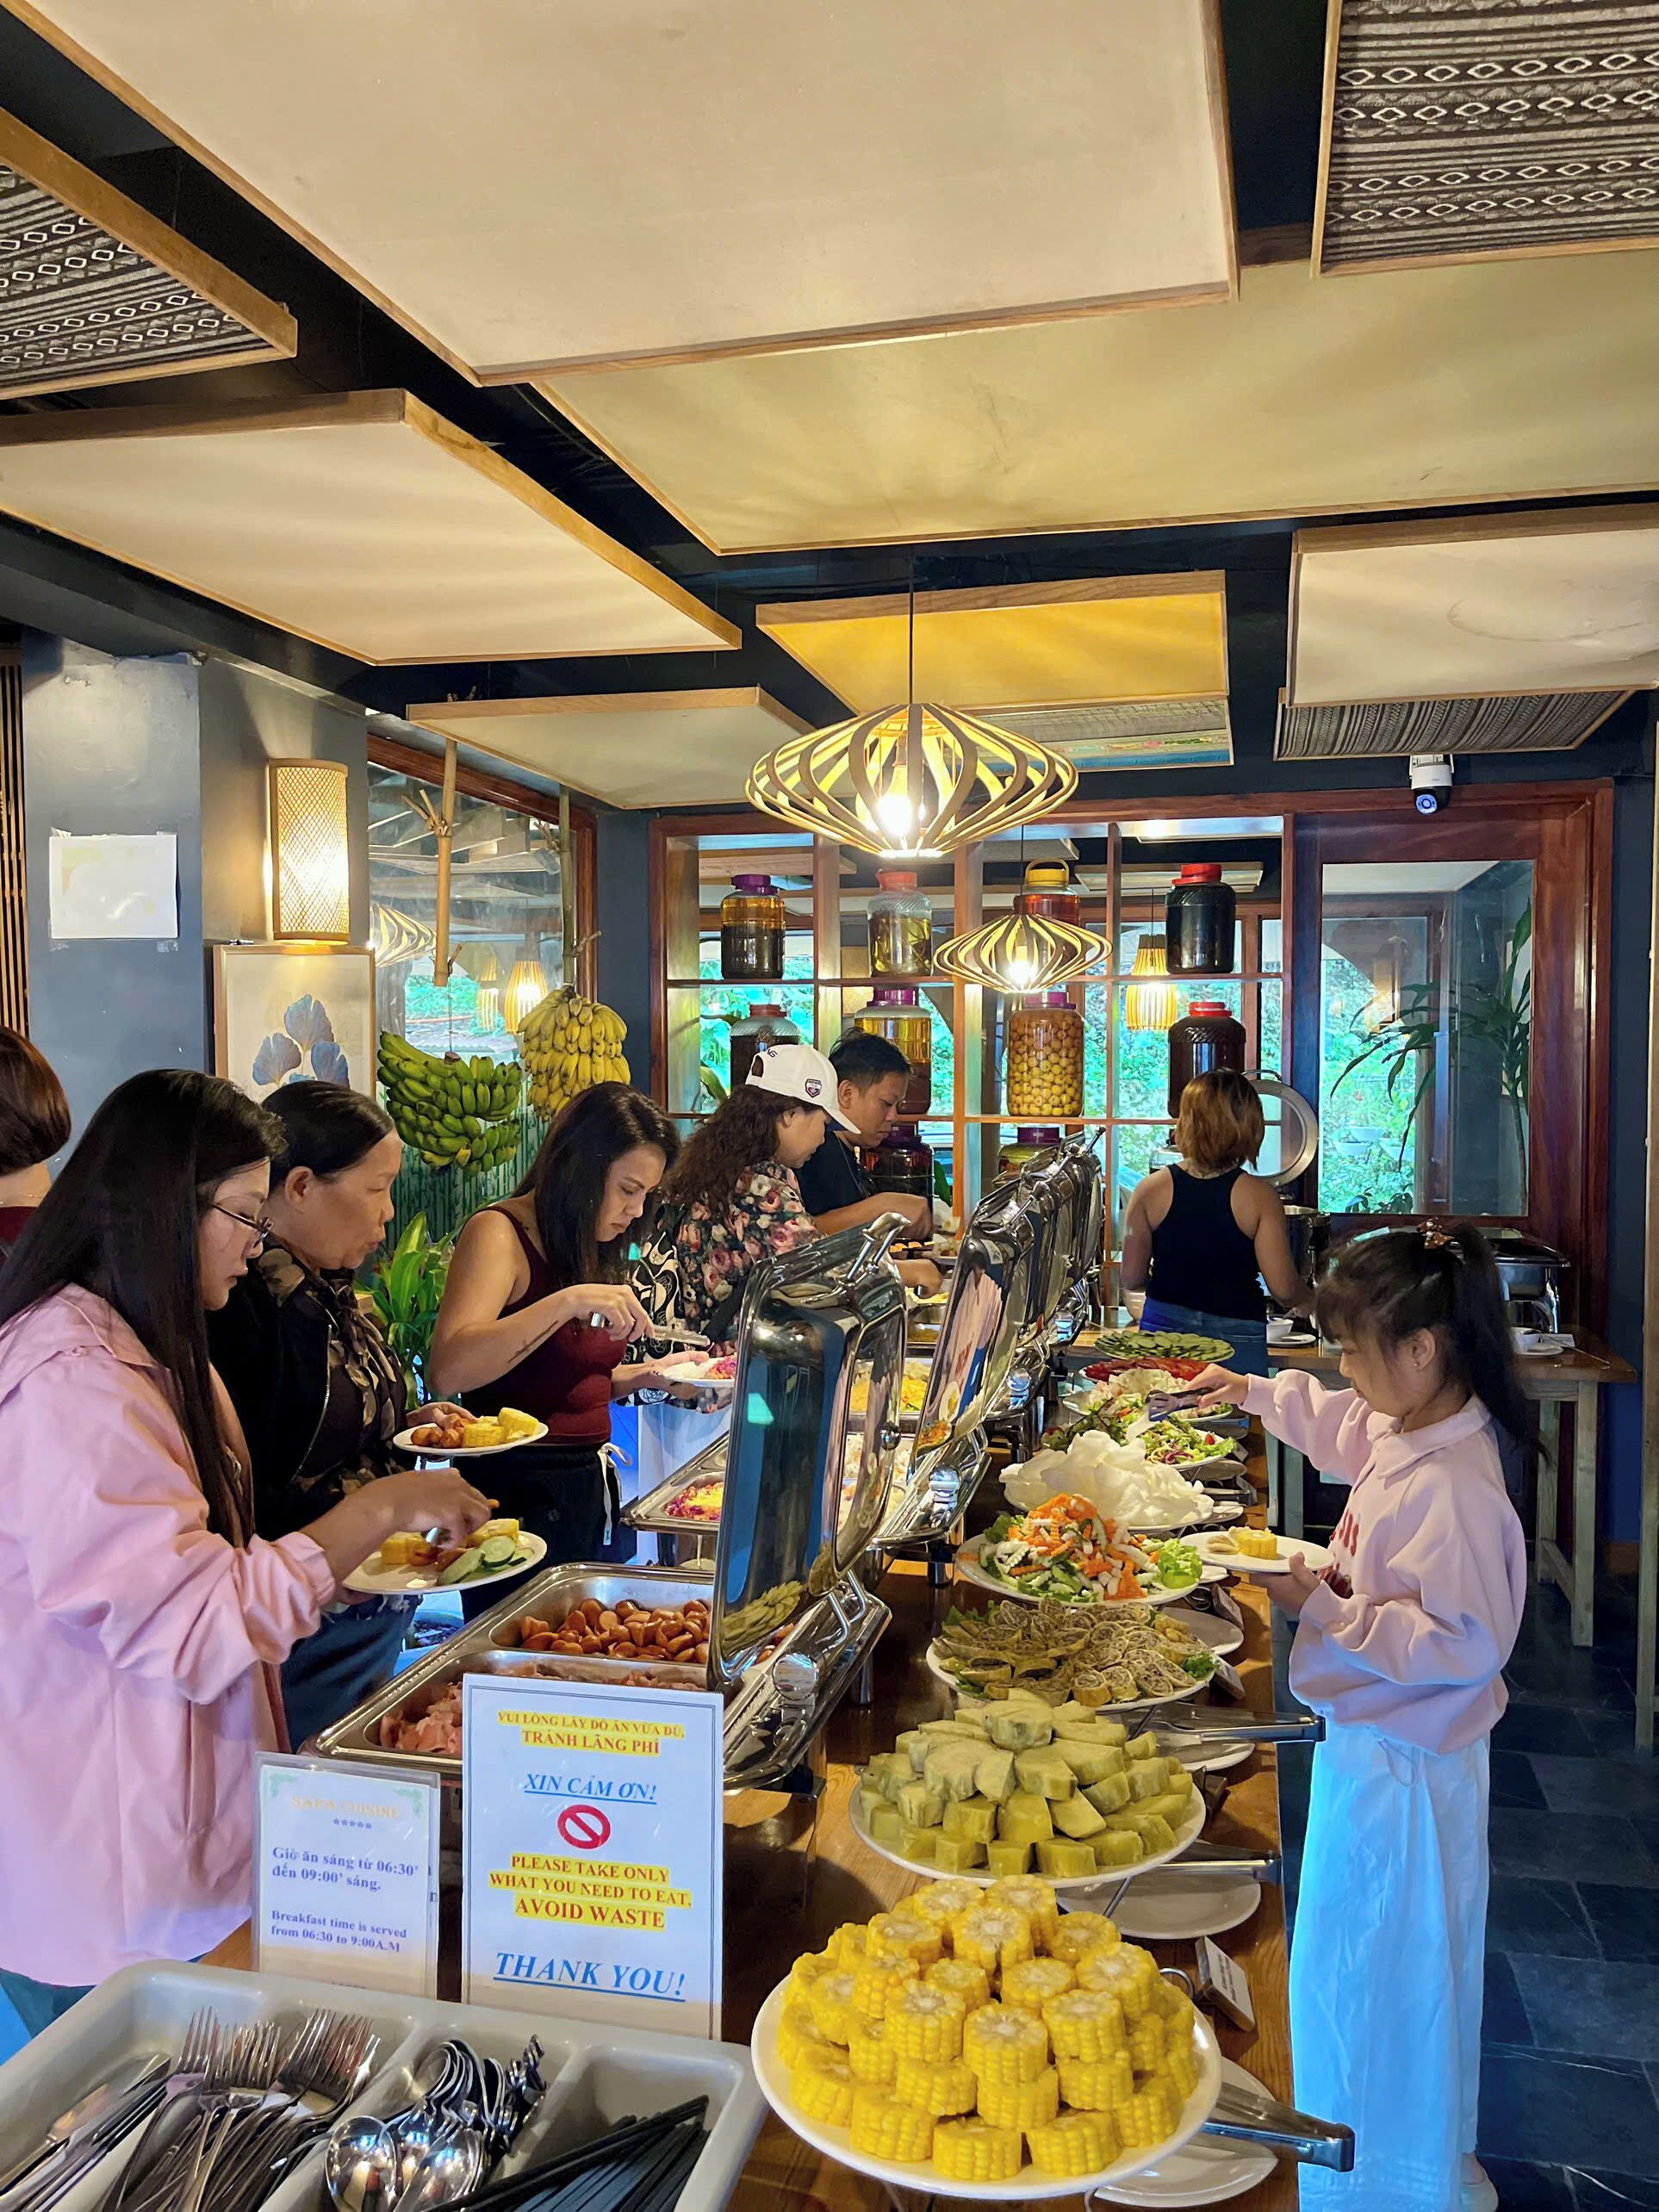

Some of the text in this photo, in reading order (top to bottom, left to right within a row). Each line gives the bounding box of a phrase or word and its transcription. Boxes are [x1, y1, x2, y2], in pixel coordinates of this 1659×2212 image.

[498, 1711, 518, 1724] VUI
[522, 1729, 659, 1754] TRÁNH LÃNG PHÍ
[524, 1774, 657, 1800] XIN CẢM ƠN!
[272, 1846, 299, 1860] Giờ
[302, 1851, 319, 1863] ăn
[323, 1854, 354, 1870] sáng
[511, 1855, 668, 1883] PLEASE TAKE ONLY
[272, 1862, 296, 1878] đến
[346, 1874, 382, 1892] sáng.
[489, 1873, 692, 1907] WHAT YOU NEED TO EAT,
[271, 1910, 407, 1938] Breakfast time is served
[515, 1898, 665, 1928] AVOID WASTE
[271, 1925, 299, 1937] from
[302, 1929, 332, 1942] 06:30
[336, 1935, 347, 1944] to
[496, 1953, 686, 1996] THANK YOU!
